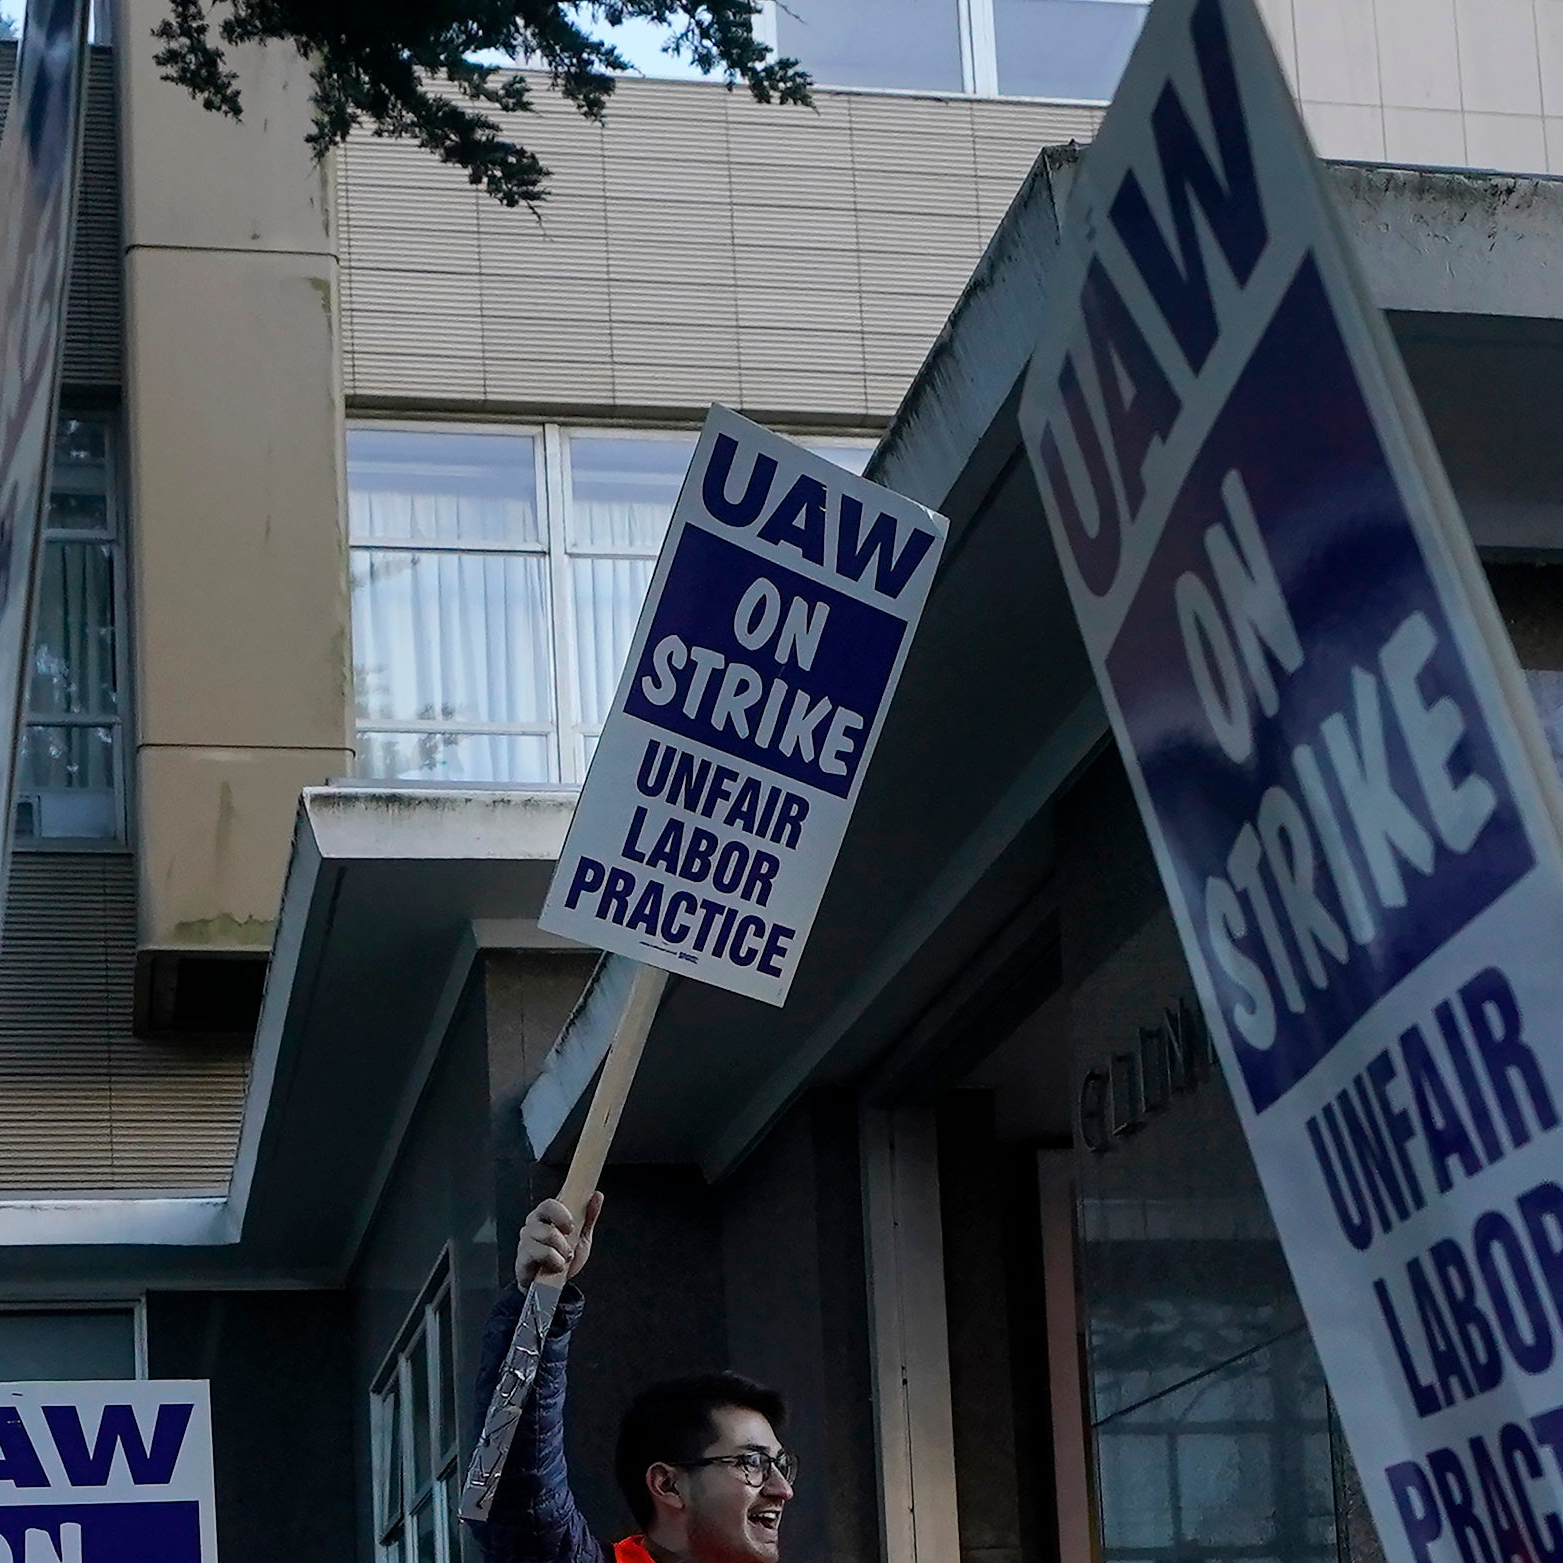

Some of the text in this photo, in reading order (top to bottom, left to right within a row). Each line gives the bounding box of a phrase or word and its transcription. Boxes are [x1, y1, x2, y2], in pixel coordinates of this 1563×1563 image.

[1040, 0, 1270, 598] UAW
[701, 432, 935, 600] UAW
[734, 576, 831, 672] ON
[1174, 469, 1304, 764] ON
[641, 633, 865, 776] STRIKE
[622, 806, 780, 908] LABOR
[637, 739, 810, 850] UNFAIR
[1205, 610, 1497, 1051] STRIKE
[564, 856, 796, 979] PRACTICE
[1306, 965, 1561, 1252] UNFAIR
